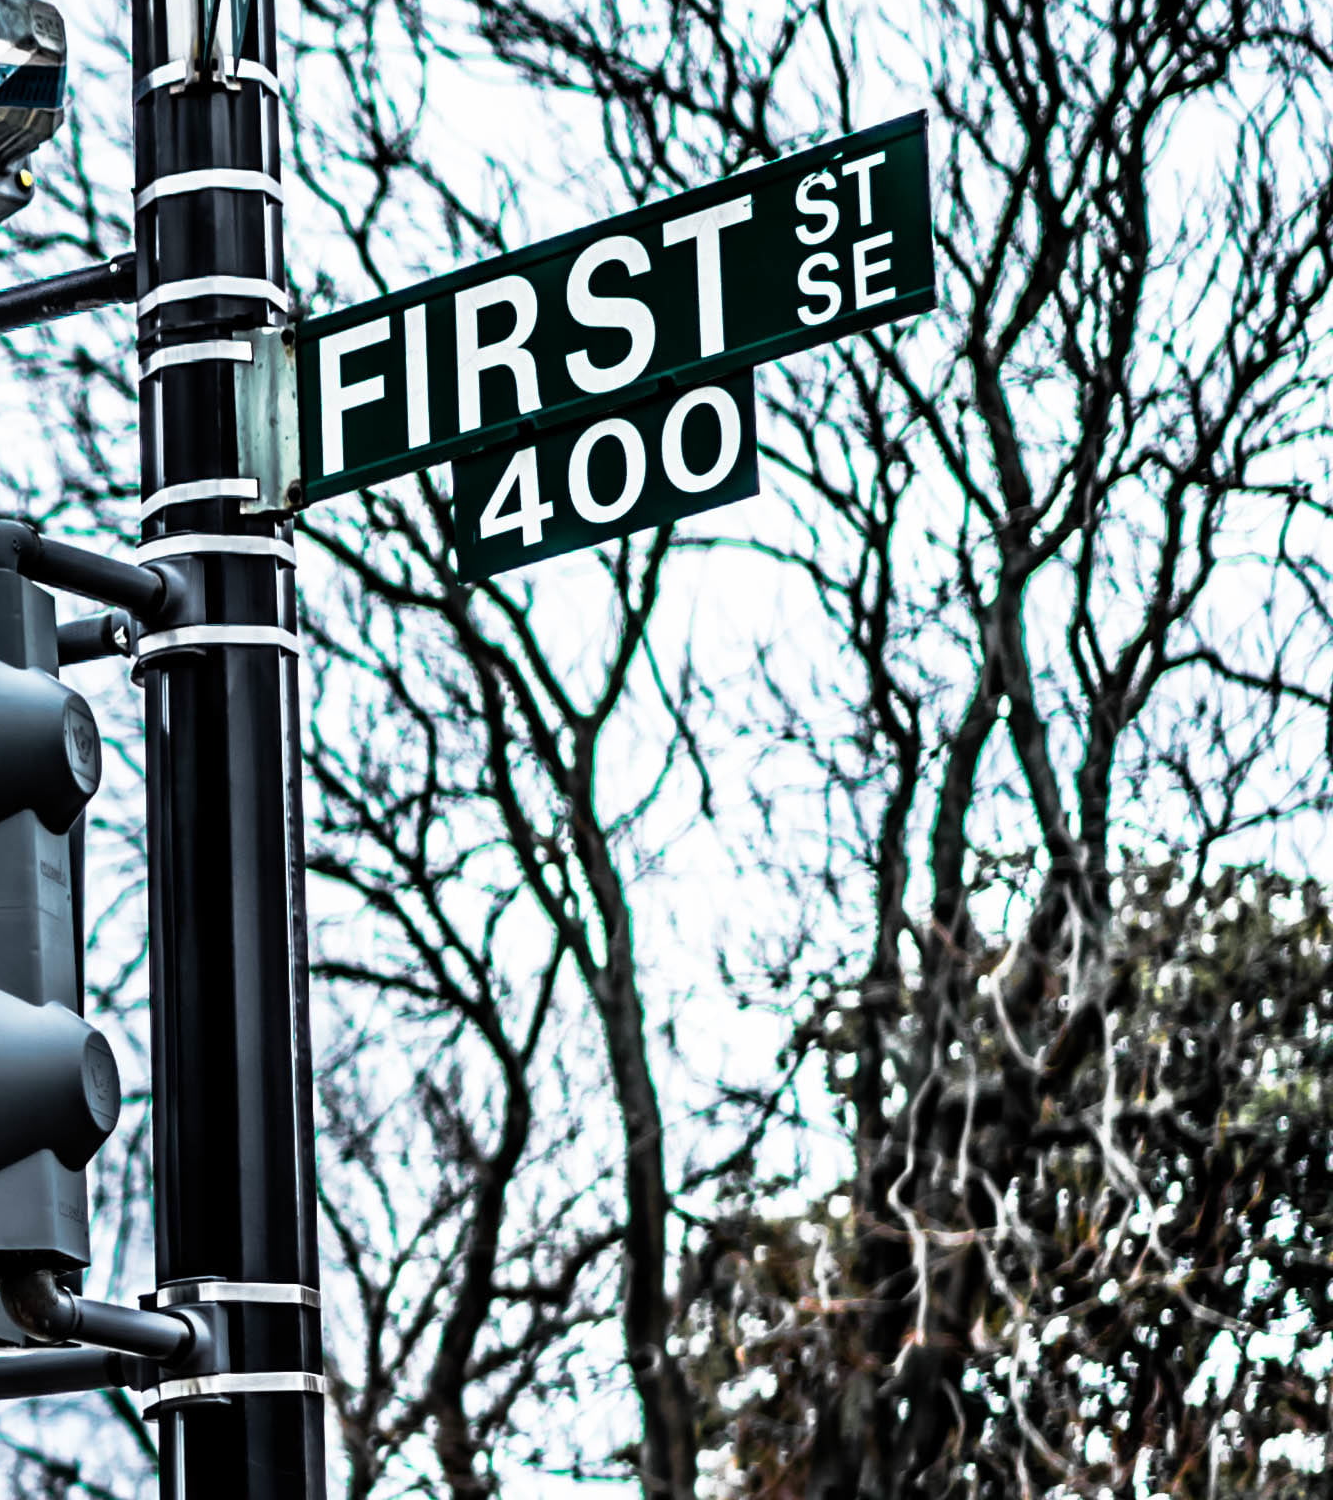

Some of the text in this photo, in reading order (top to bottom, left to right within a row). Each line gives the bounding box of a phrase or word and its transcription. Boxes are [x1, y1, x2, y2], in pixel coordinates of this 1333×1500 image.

[319, 151, 886, 476] FIRST ST
[797, 232, 896, 326] SE
[479, 385, 741, 546] 400
